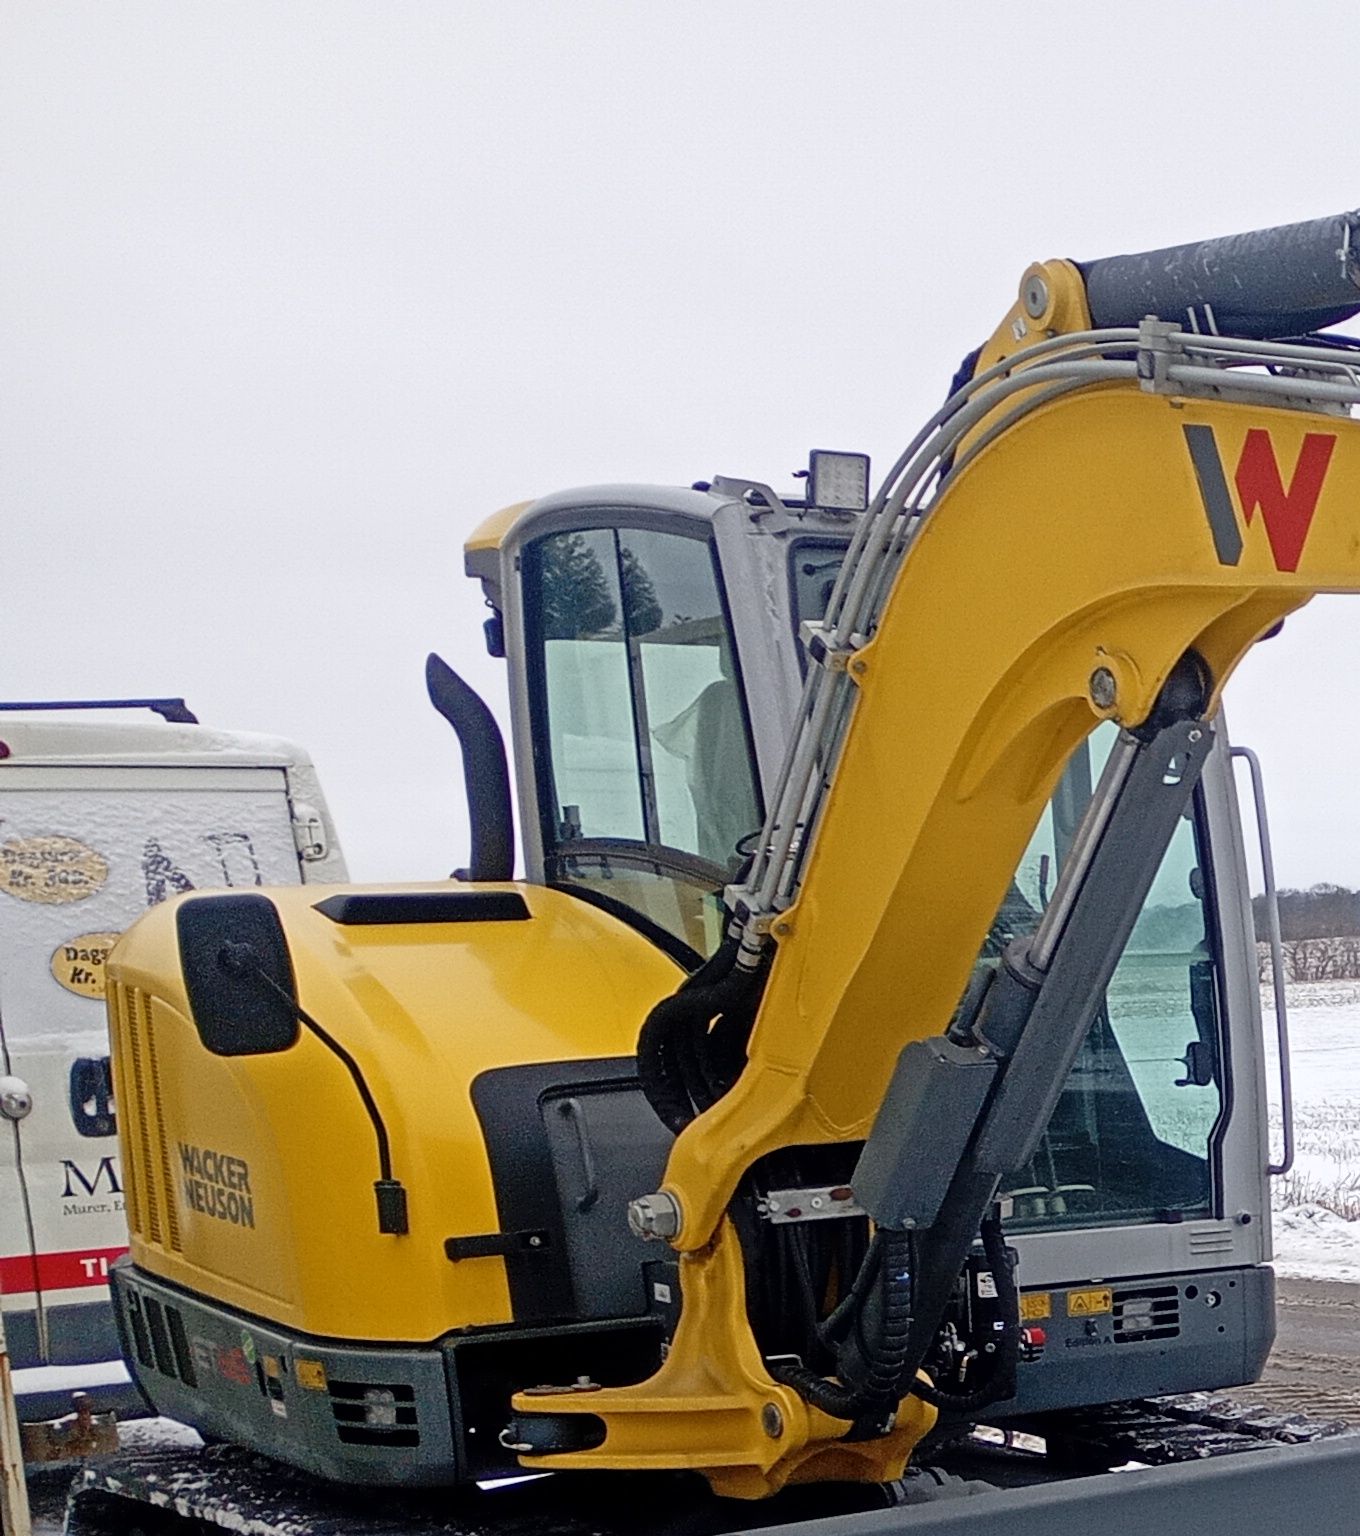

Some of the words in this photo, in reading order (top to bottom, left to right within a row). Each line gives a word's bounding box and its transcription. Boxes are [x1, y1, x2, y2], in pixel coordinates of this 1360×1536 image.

[70, 966, 97, 985] Kr.
[178, 1141, 252, 1195] WACKER
[185, 1178, 255, 1230] NEUSON
